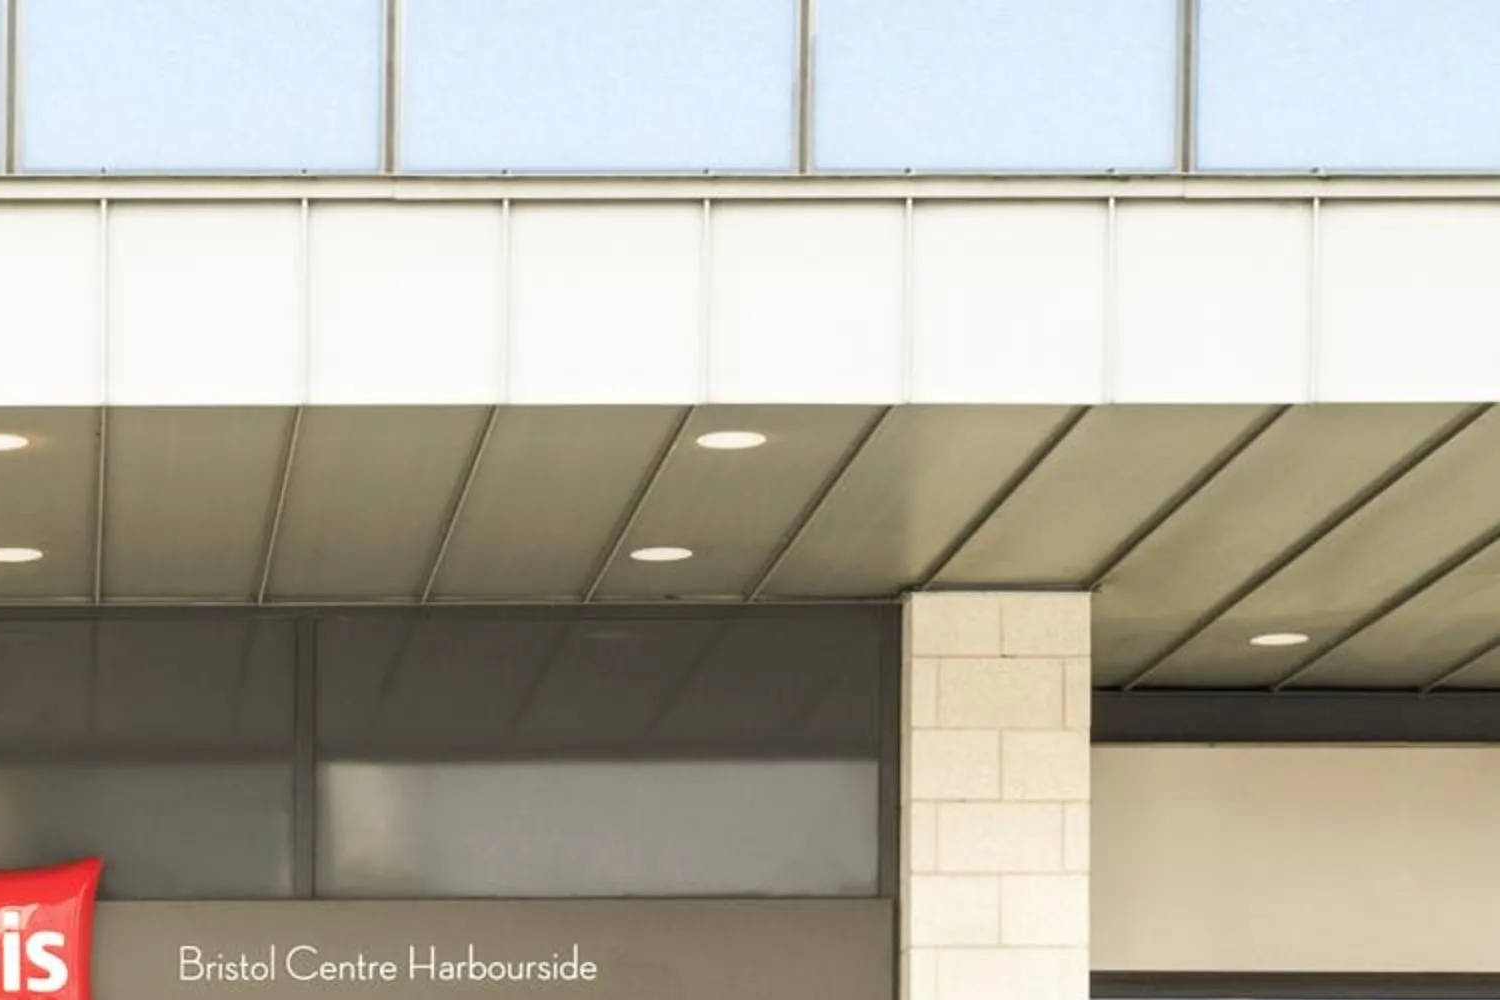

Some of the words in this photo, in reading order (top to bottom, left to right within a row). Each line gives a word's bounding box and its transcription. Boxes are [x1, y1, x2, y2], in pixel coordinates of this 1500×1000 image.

[179, 943, 275, 981] Bristol
[286, 944, 398, 981] Centre
[409, 943, 598, 981] Harbourside
